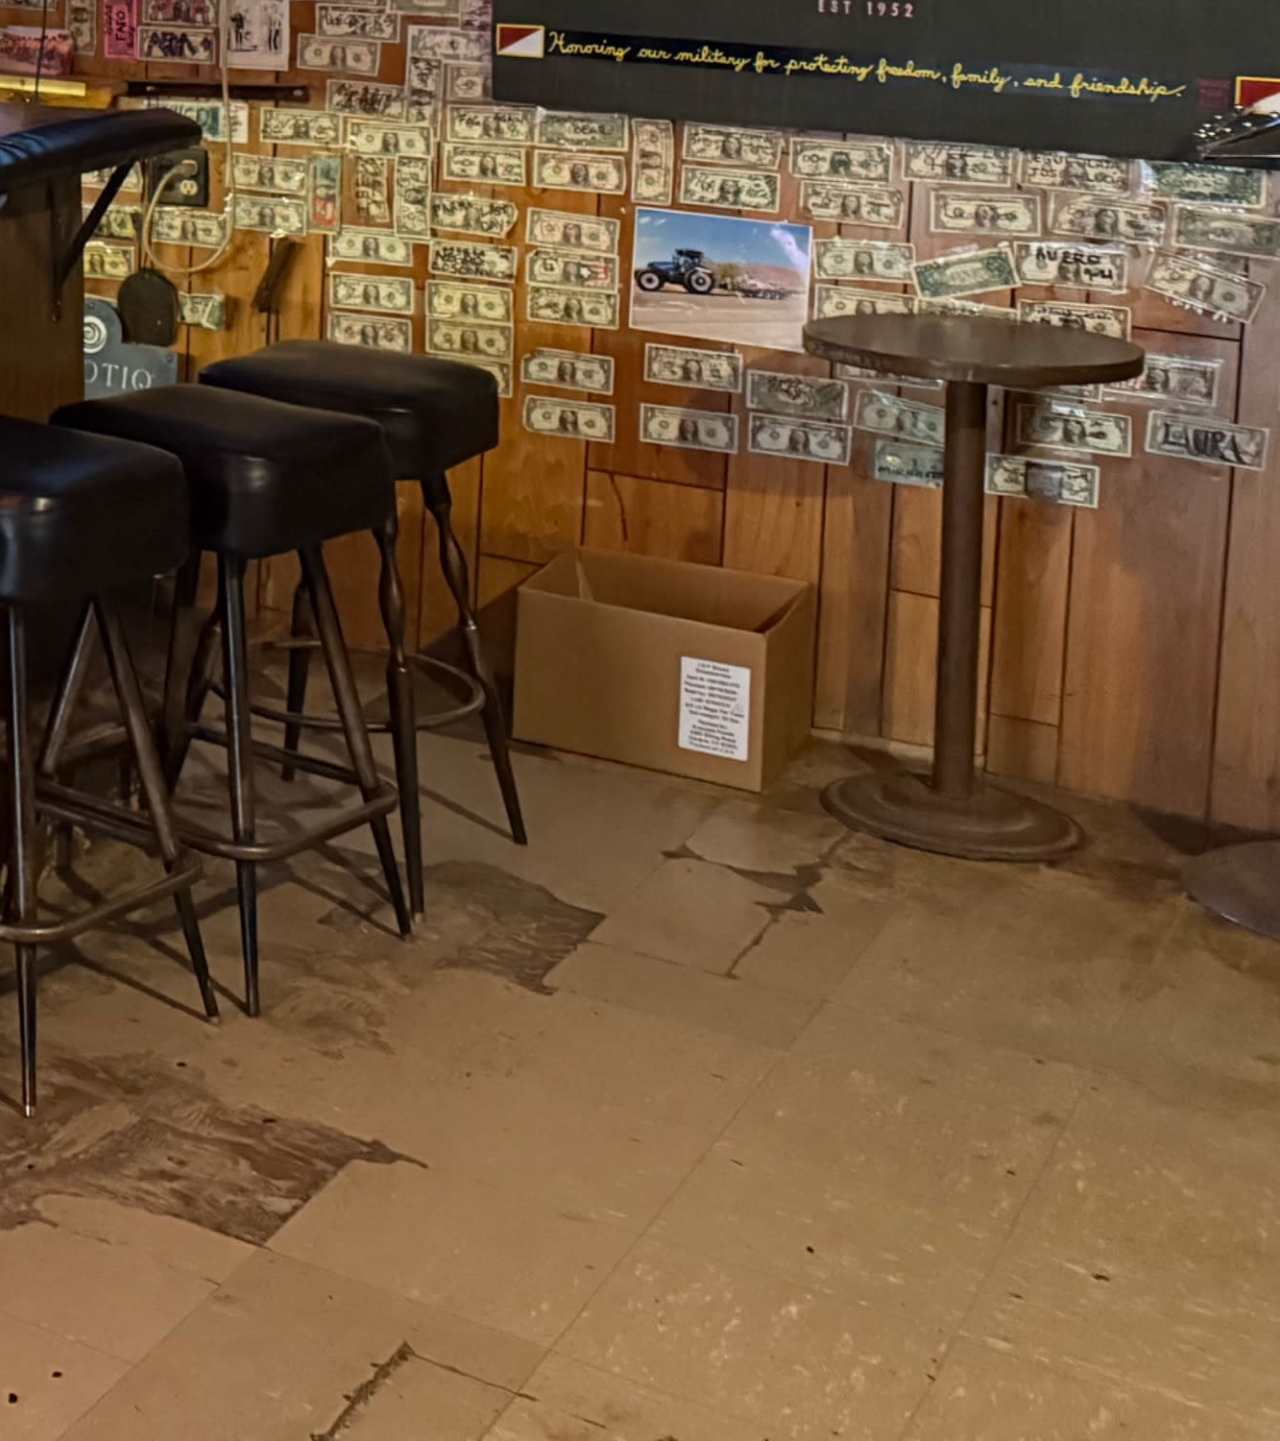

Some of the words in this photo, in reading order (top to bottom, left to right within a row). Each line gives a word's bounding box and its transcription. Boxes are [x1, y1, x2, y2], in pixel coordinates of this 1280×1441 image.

[866, 1, 913, 18] 1952
[548, 31, 630, 61] Honoring
[637, 47, 671, 60] our
[674, 46, 750, 72] military
[752, 52, 781, 73] for
[784, 54, 873, 82] protecting
[1024, 72, 1063, 89] and
